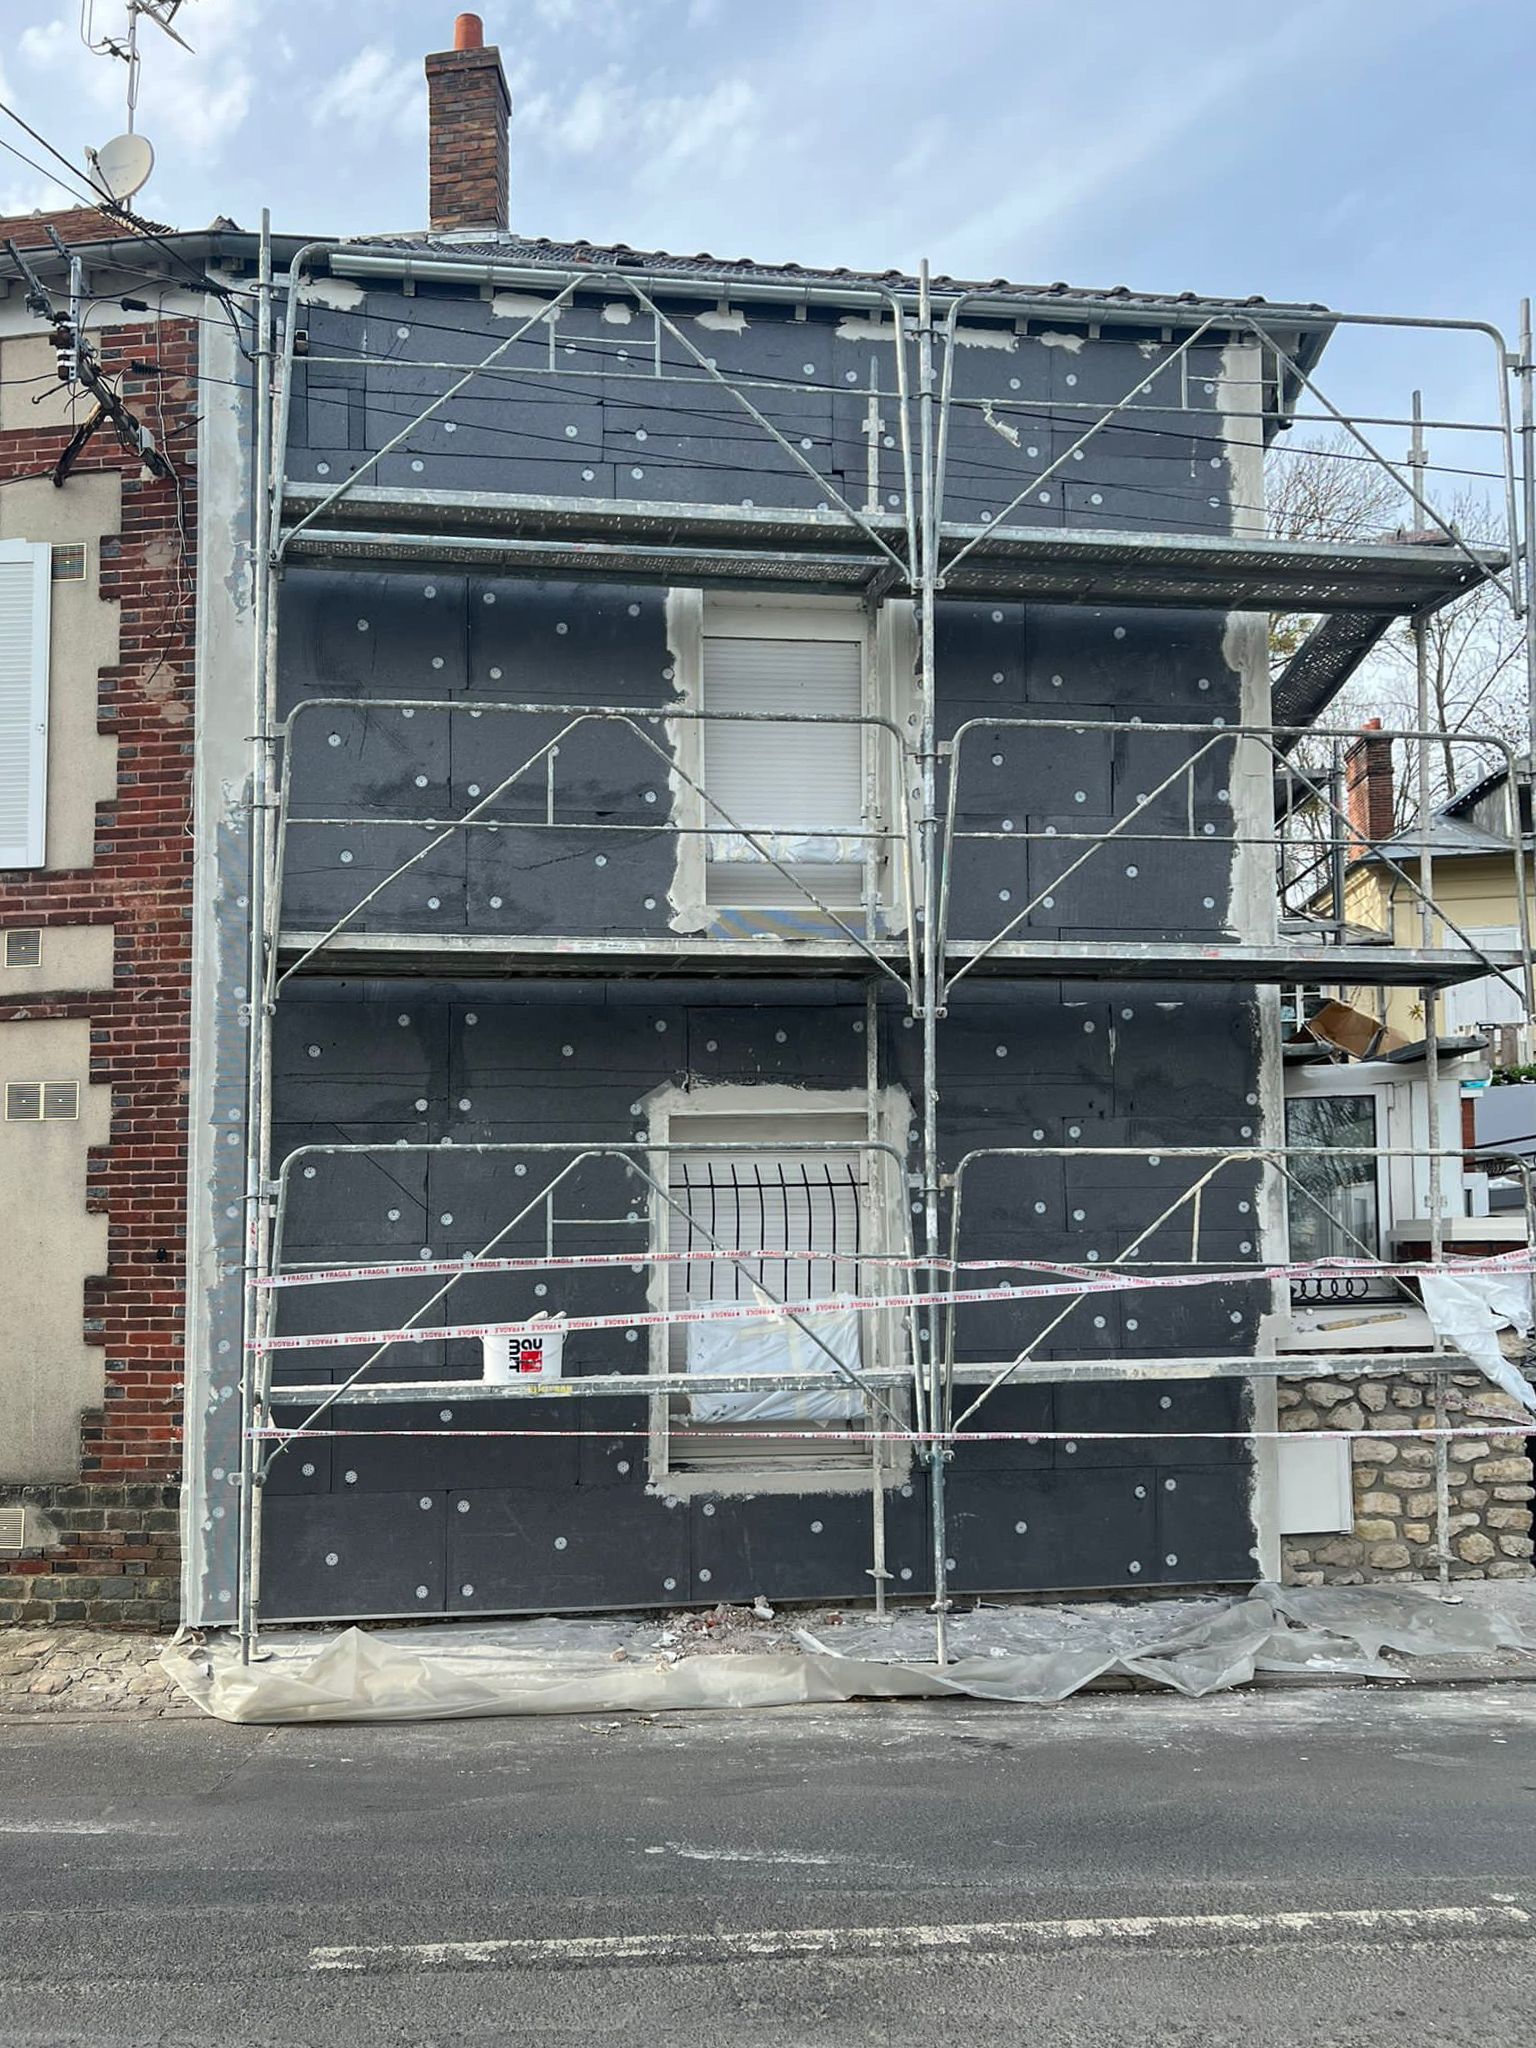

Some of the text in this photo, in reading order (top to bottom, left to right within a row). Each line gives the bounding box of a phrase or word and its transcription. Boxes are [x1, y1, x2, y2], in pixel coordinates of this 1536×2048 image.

[287, 1273, 314, 1281] FRAGILE
[325, 1270, 352, 1278] FRAGILE
[363, 1267, 389, 1275] FRAGILE
[438, 1263, 464, 1271] FRAGILE
[585, 1255, 610, 1263] FRAGILE
